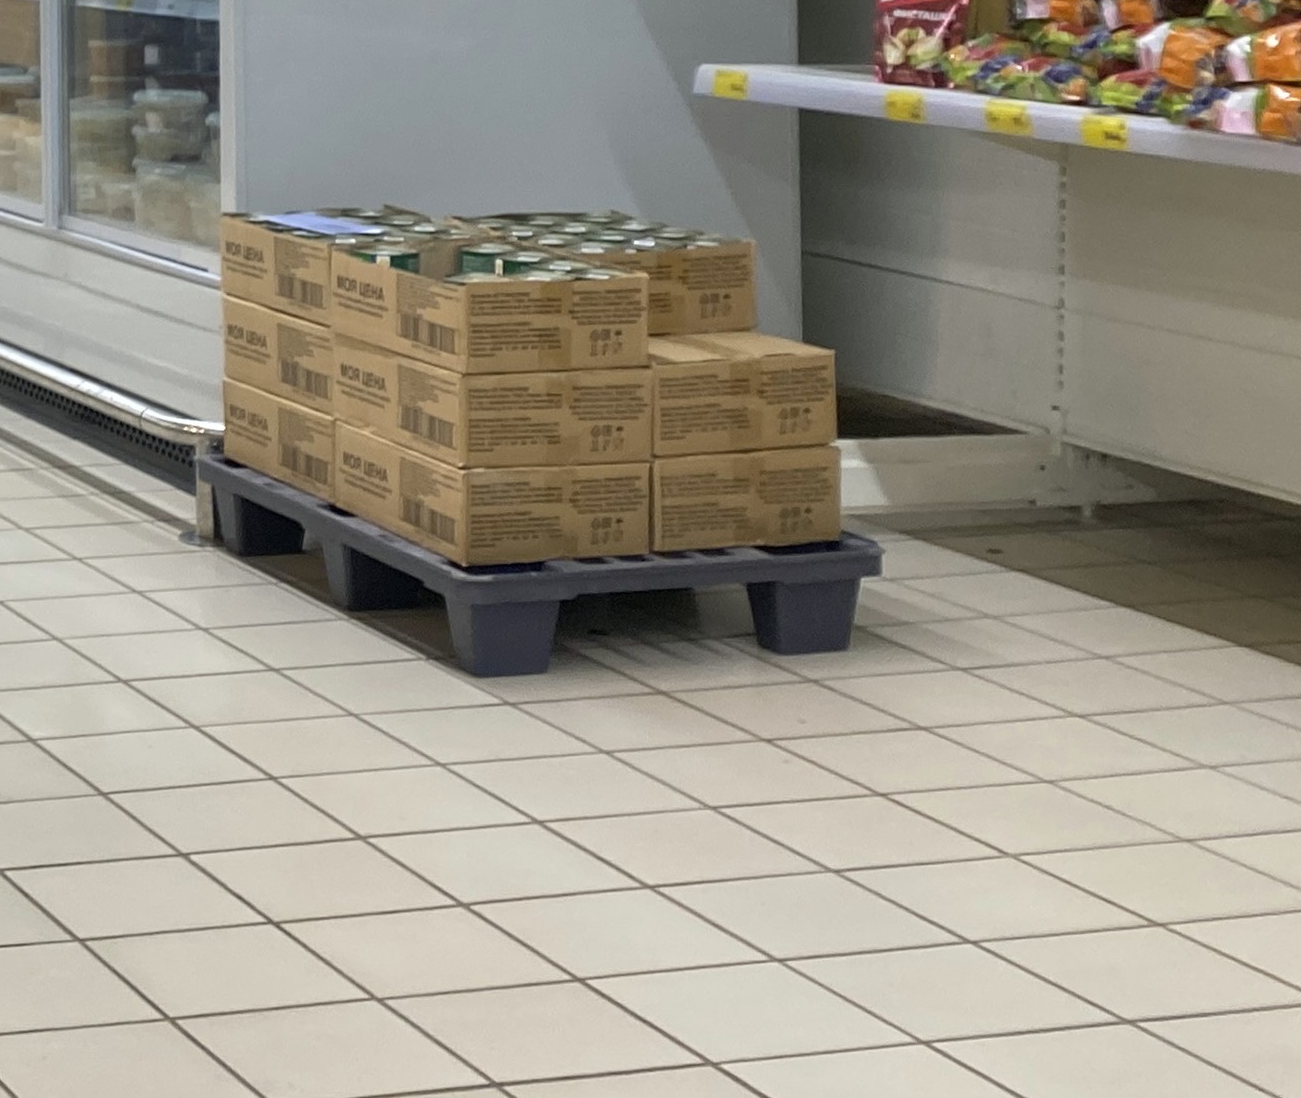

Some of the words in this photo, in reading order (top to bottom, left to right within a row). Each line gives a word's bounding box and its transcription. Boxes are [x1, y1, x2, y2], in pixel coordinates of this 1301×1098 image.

[337, 275, 357, 293] МОЯ
[359, 281, 385, 302] ЦЕНА
[340, 362, 360, 382] МОЯ
[362, 370, 386, 392] ЦЕНА
[343, 451, 361, 470] МОЯ
[363, 460, 388, 483] ЦЕНА
